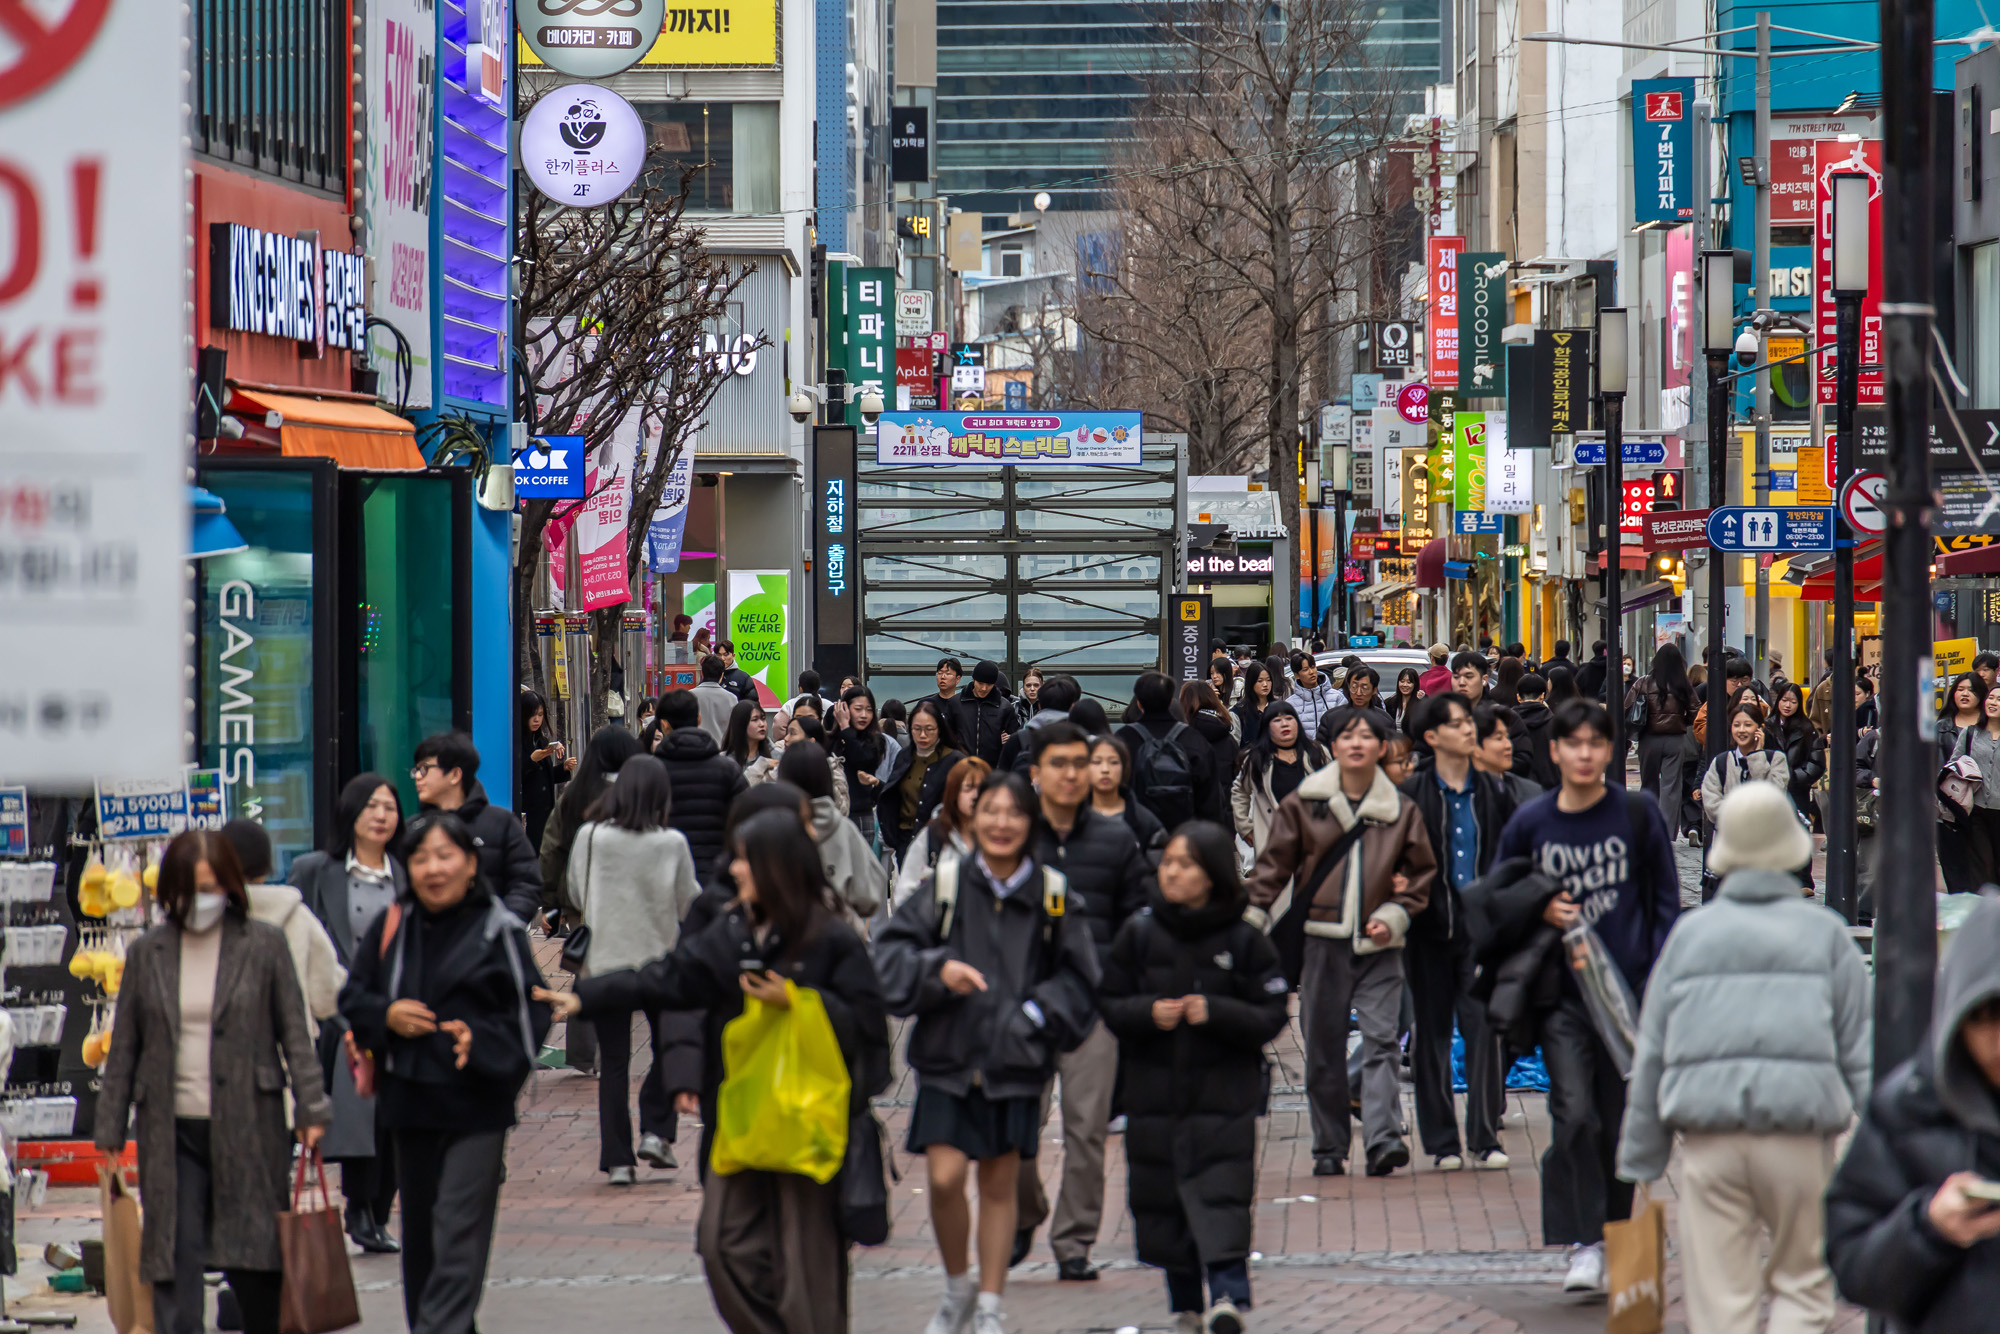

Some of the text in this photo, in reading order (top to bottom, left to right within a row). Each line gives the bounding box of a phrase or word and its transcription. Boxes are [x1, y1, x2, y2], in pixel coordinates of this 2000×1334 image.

[547, 29, 633, 46] 베이커리 카페
[1788, 122, 1845, 133] 7TH STREET PIZZA
[544, 157, 620, 175] 한끼플러스
[1658, 124, 1676, 209] 7번가피자
[573, 184, 591, 196] 2F
[229, 222, 263, 333] KING
[264, 231, 314, 342] GAMES
[1438, 248, 1456, 316] 제이원
[903, 295, 923, 305] CCR
[1474, 262, 1489, 378] CROCODIL
[1864, 315, 1882, 376] Cran
[1552, 347, 1572, 431] 한국공인금거래소
[972, 418, 988, 428] 국내
[1006, 418, 1028, 428] 캐릭터
[1029, 418, 1051, 428] 상점가
[893, 445, 941, 457] 22개 상점
[949, 433, 1070, 458] 캐릭터 스트리트
[531, 476, 568, 485] COFFEE
[1786, 511, 1824, 520] 개방화장실
[826, 479, 846, 596] 지하철 출입구
[1208, 556, 1234, 572] the
[739, 613, 778, 623] HELLO
[738, 624, 781, 633] WE ARE
[741, 642, 776, 651] OLIVE
[739, 652, 781, 661] YOUNG
[1935, 651, 1960, 660] ALL DAY
[219, 579, 254, 788] GAMES
[676, 673, 694, 684] 70%
